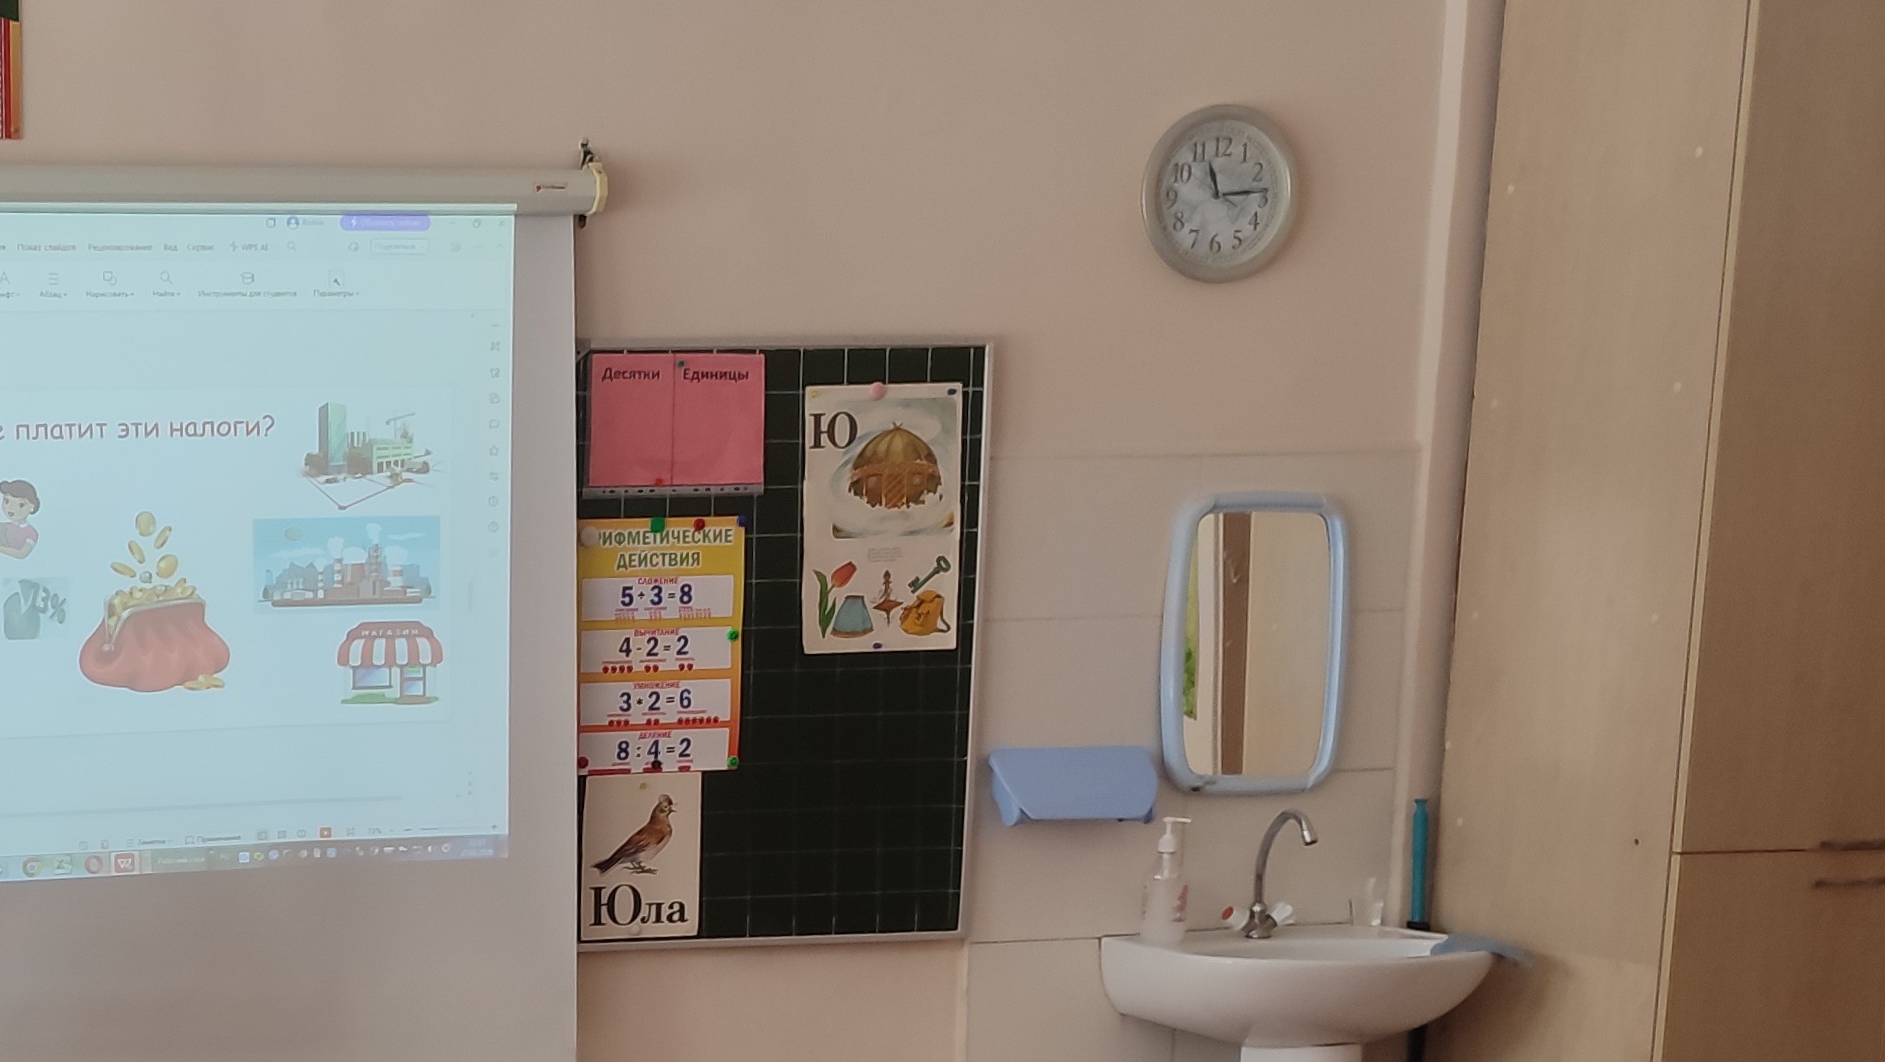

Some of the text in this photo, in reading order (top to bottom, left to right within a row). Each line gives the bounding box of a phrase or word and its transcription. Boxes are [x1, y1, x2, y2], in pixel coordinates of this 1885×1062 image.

[1192, 141, 1206, 162] 11
[1215, 137, 1233, 157] 12
[1242, 142, 1248, 163] 1
[1173, 163, 1192, 184] 10
[1252, 162, 1264, 182] 2
[1166, 188, 1178, 209] 9
[1258, 188, 1269, 208] 3
[1172, 211, 1185, 232] 8
[1249, 211, 1260, 231] 4
[1188, 229, 1199, 249] 7
[1210, 233, 1221, 253] 6
[1232, 230, 1242, 250] 5
[602, 366, 660, 383] Десятки
[683, 366, 750, 384] Единицы
[15, 420, 107, 441] платит
[116, 420, 159, 439] эти
[168, 414, 276, 439] налоги?
[808, 411, 859, 451] Ю
[599, 528, 733, 547] ИФМЕТИЧЕСКИЕ
[616, 551, 701, 571] ДЕЙСТВИЯ
[620, 585, 634, 607] 5
[650, 584, 663, 605] 3
[679, 583, 693, 604] 8
[618, 637, 632, 657] 4
[645, 636, 659, 656] 2
[675, 635, 689, 655] 2
[618, 691, 632, 712] 3
[647, 691, 661, 711] 2
[679, 688, 692, 709] 6
[616, 740, 630, 760] 8
[646, 739, 660, 759] 4
[677, 737, 692, 758] 2
[589, 884, 688, 928] Юла
